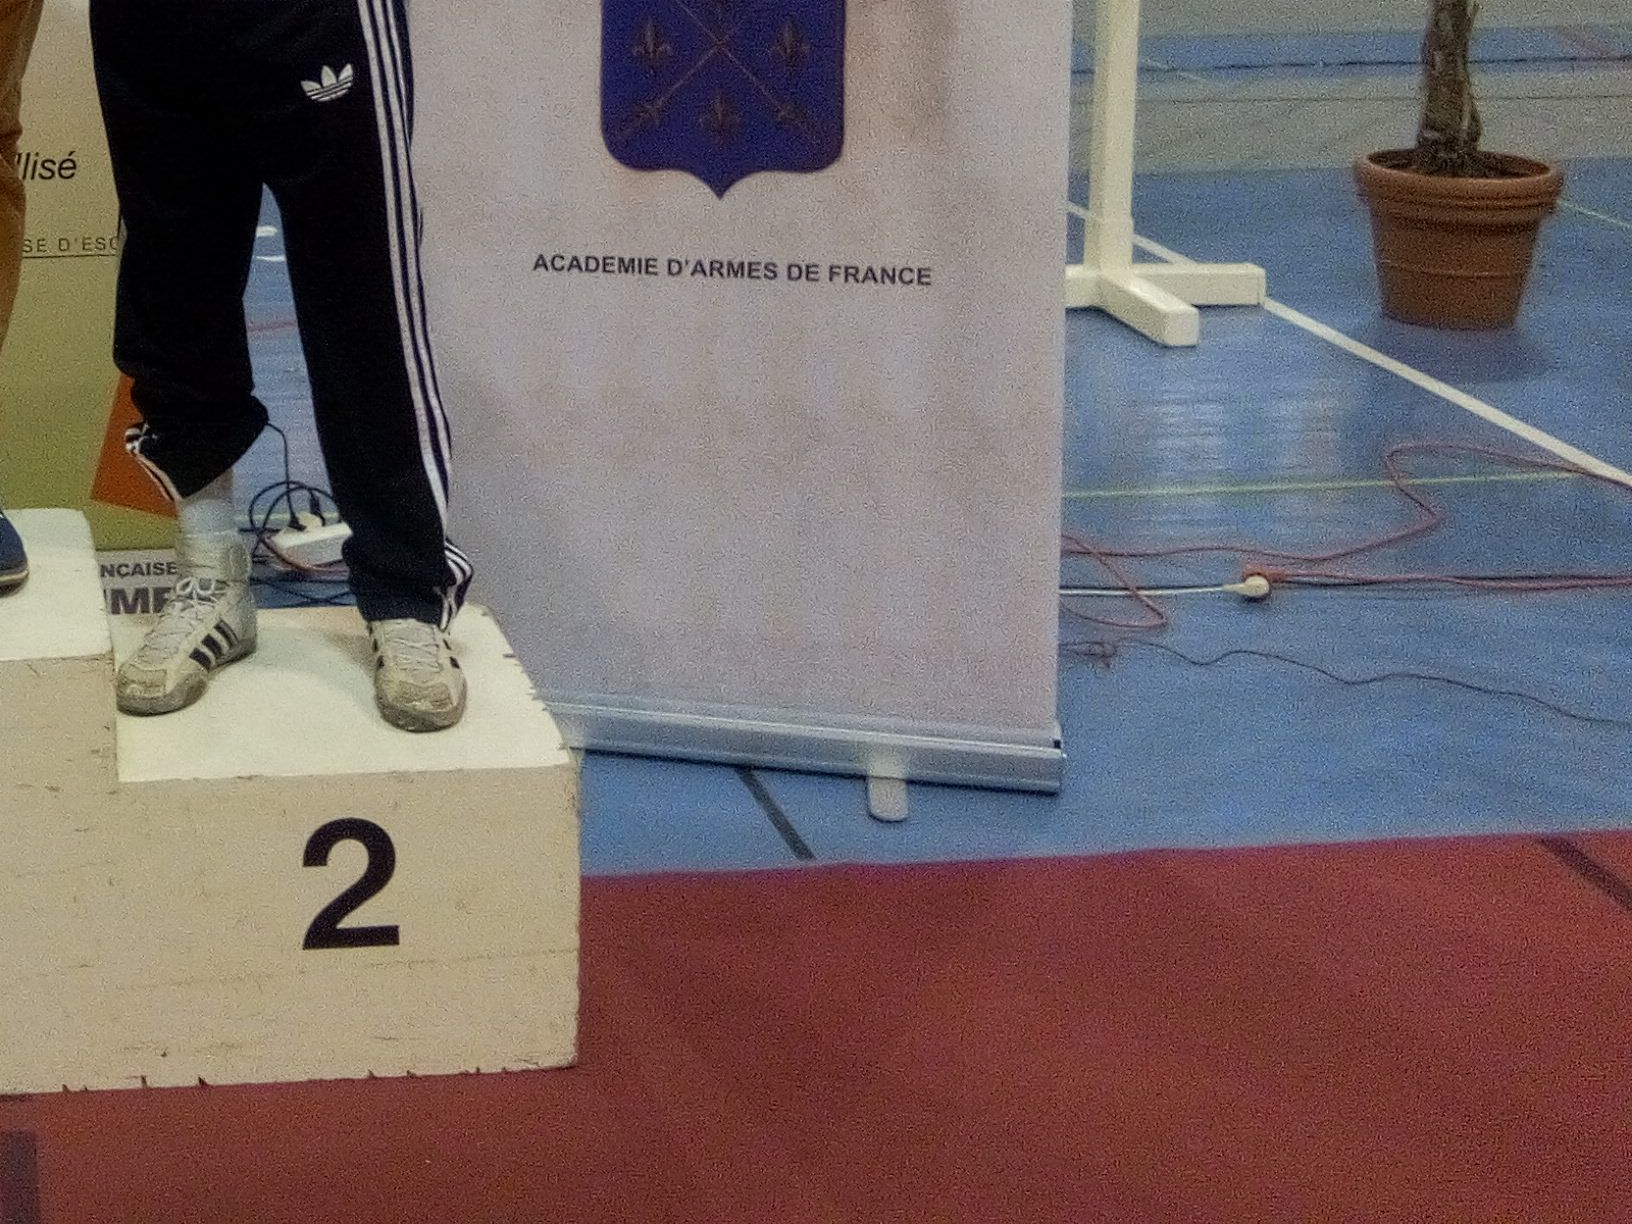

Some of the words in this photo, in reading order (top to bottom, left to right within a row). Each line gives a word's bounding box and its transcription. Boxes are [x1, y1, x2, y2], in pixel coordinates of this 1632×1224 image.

[22, 237, 48, 253] SE
[58, 236, 119, 252] D'ESC
[532, 253, 659, 276] ACADEMIE
[667, 258, 778, 281] D'ARMES
[786, 263, 820, 282] DE
[827, 264, 933, 287] FRANCE
[100, 561, 177, 579] NÇAISE
[302, 817, 401, 949] 2
